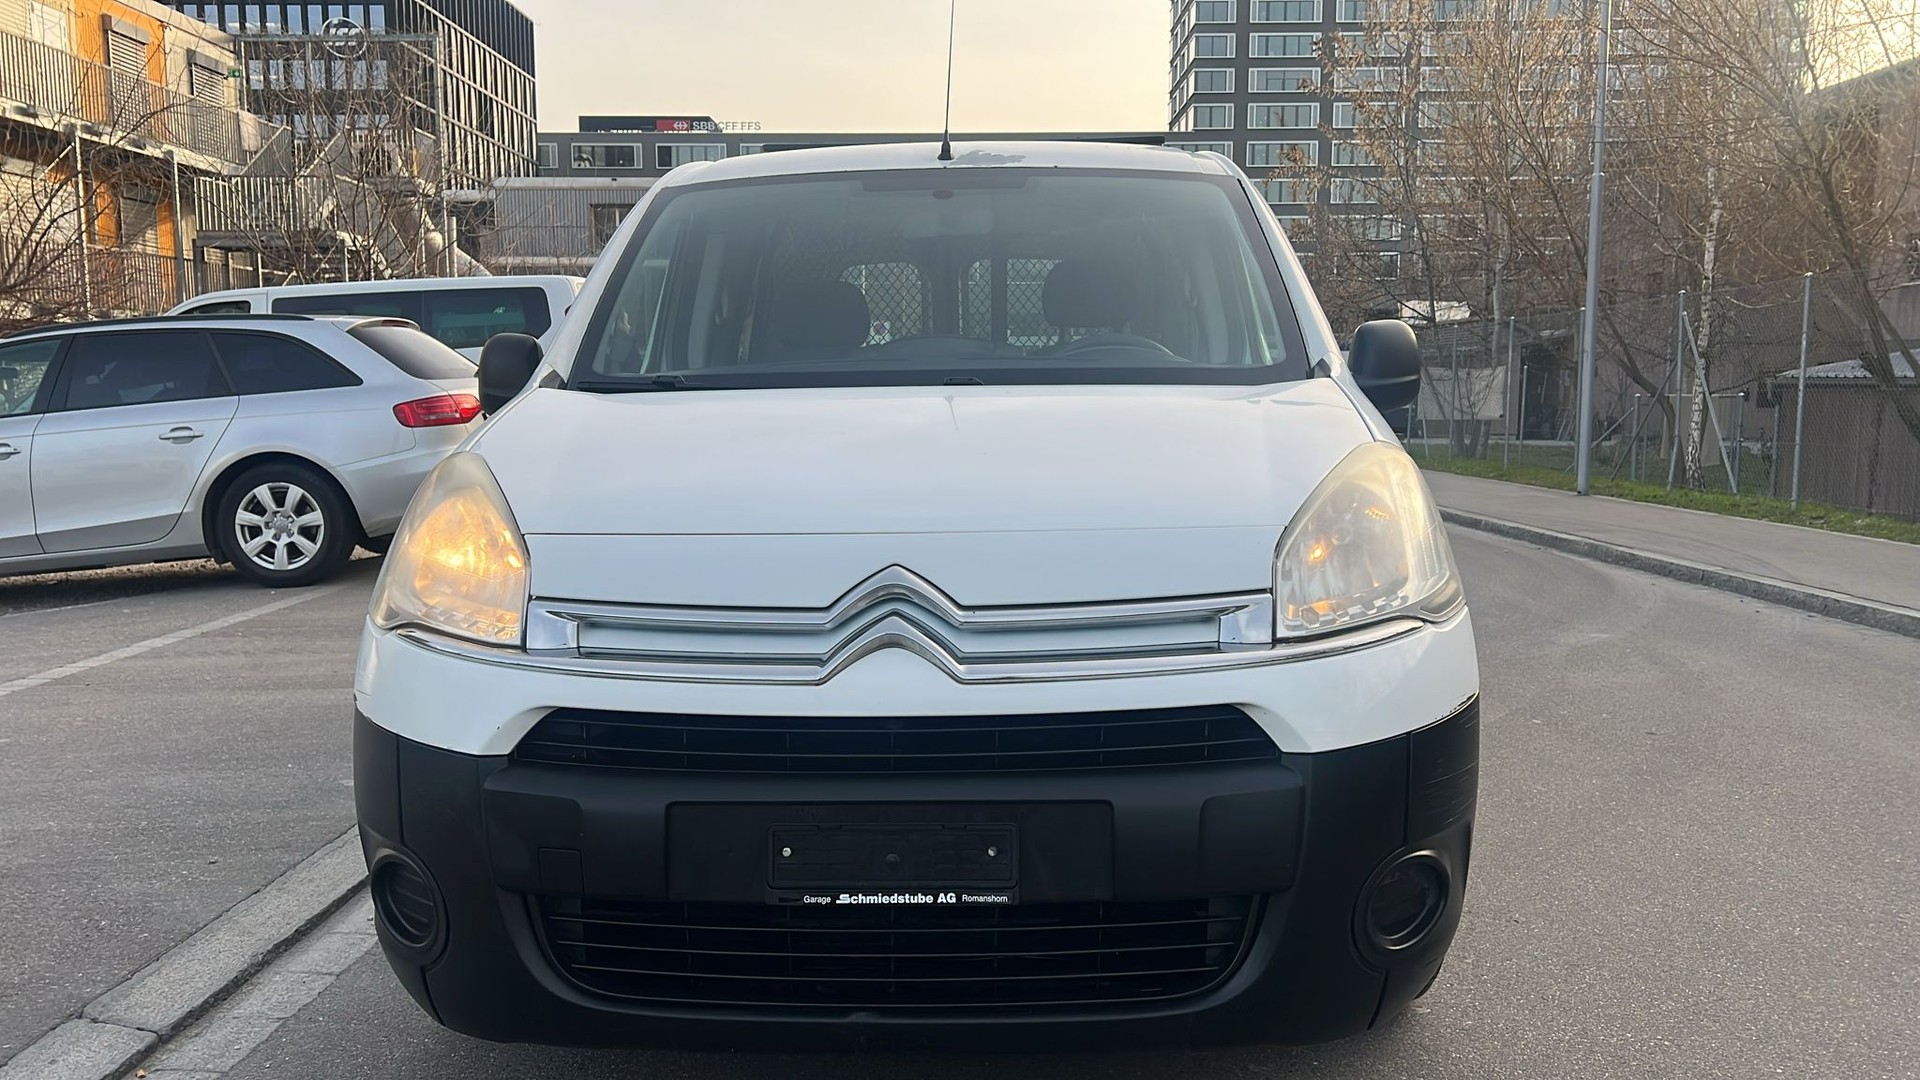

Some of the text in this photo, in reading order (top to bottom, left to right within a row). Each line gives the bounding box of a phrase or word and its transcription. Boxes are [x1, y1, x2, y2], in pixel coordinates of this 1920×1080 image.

[692, 121, 762, 131] SBB CFF FFS
[803, 892, 1008, 905] Garage Schmiedstube AG Romanshorn
